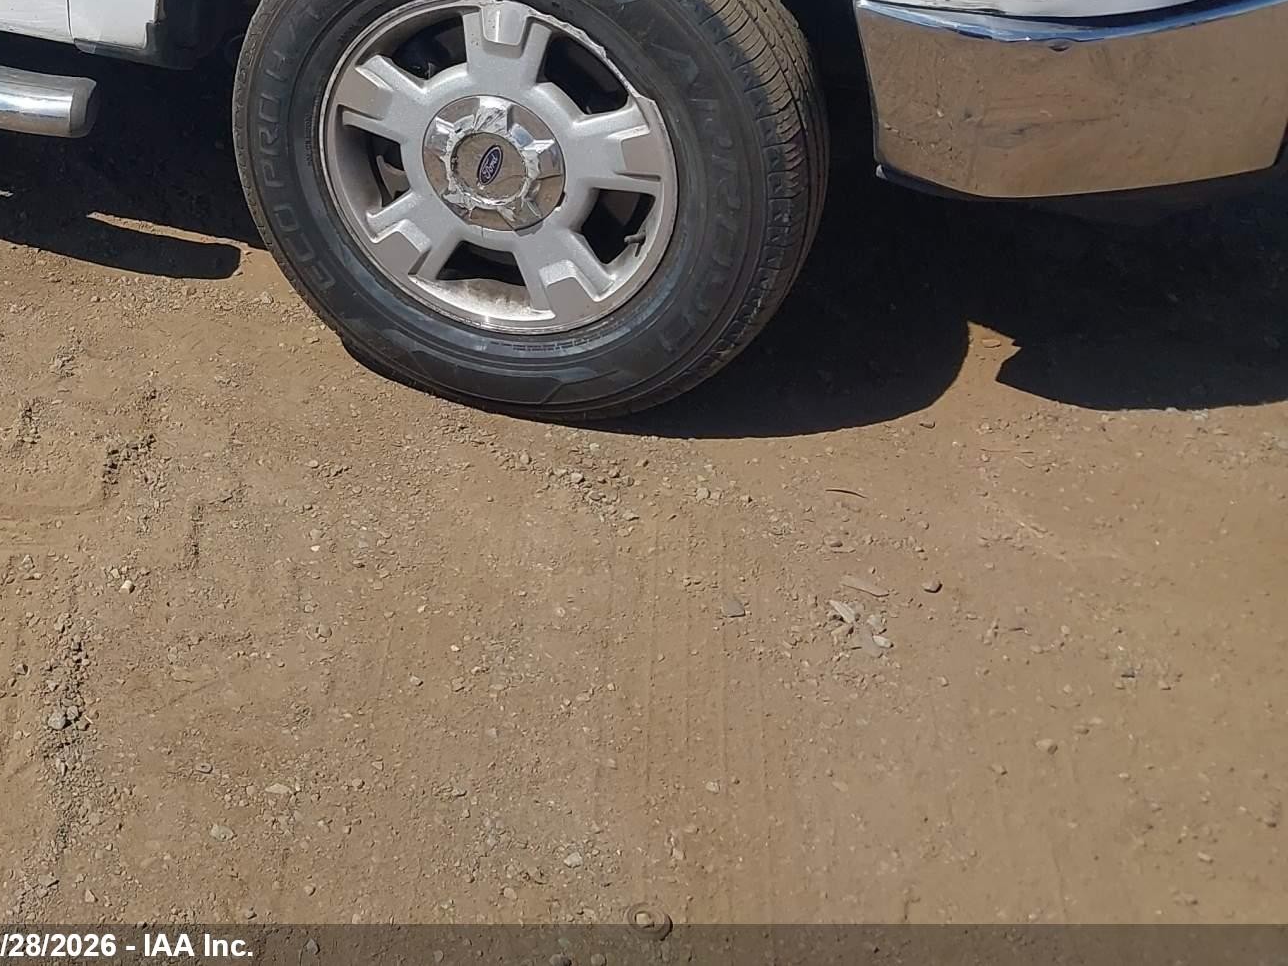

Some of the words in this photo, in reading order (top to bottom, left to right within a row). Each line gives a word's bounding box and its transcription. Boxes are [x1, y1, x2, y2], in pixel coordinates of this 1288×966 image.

[259, 92, 283, 189] PRO
[480, 150, 500, 181] Ford
[273, 203, 337, 289] ECO
